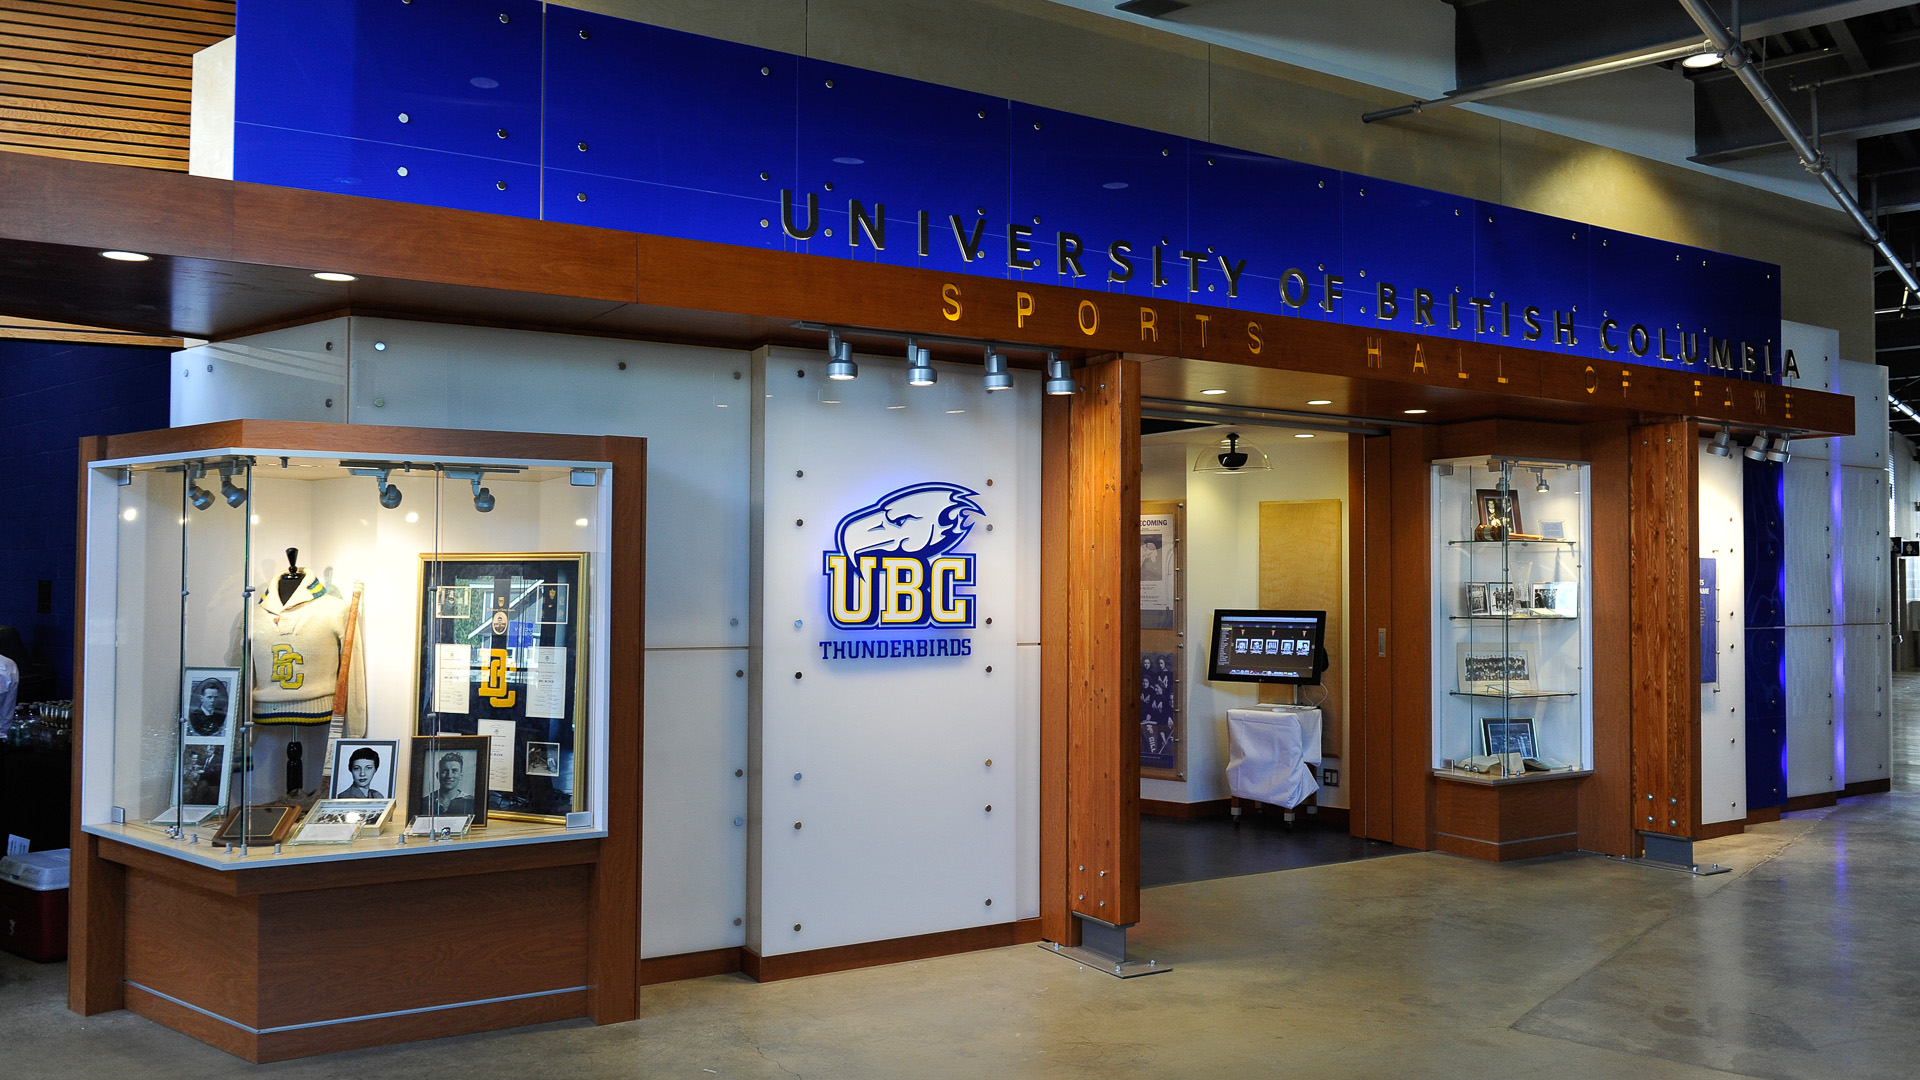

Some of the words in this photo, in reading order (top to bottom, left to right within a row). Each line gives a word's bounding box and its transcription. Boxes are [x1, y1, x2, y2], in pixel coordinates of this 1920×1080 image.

[780, 189, 1247, 298] UNIVERSITY
[1279, 267, 1343, 313] OF
[1376, 282, 1575, 347] BRITISH
[1601, 318, 1800, 379] COLUMBIA
[942, 283, 1263, 354] SPORTS
[1367, 336, 1508, 383] HALL
[1585, 365, 1631, 398] OF
[1694, 380, 1793, 419] FAME
[828, 554, 968, 624] UBC
[271, 644, 304, 690] BC
[819, 638, 972, 660] THUNDERBIRDS
